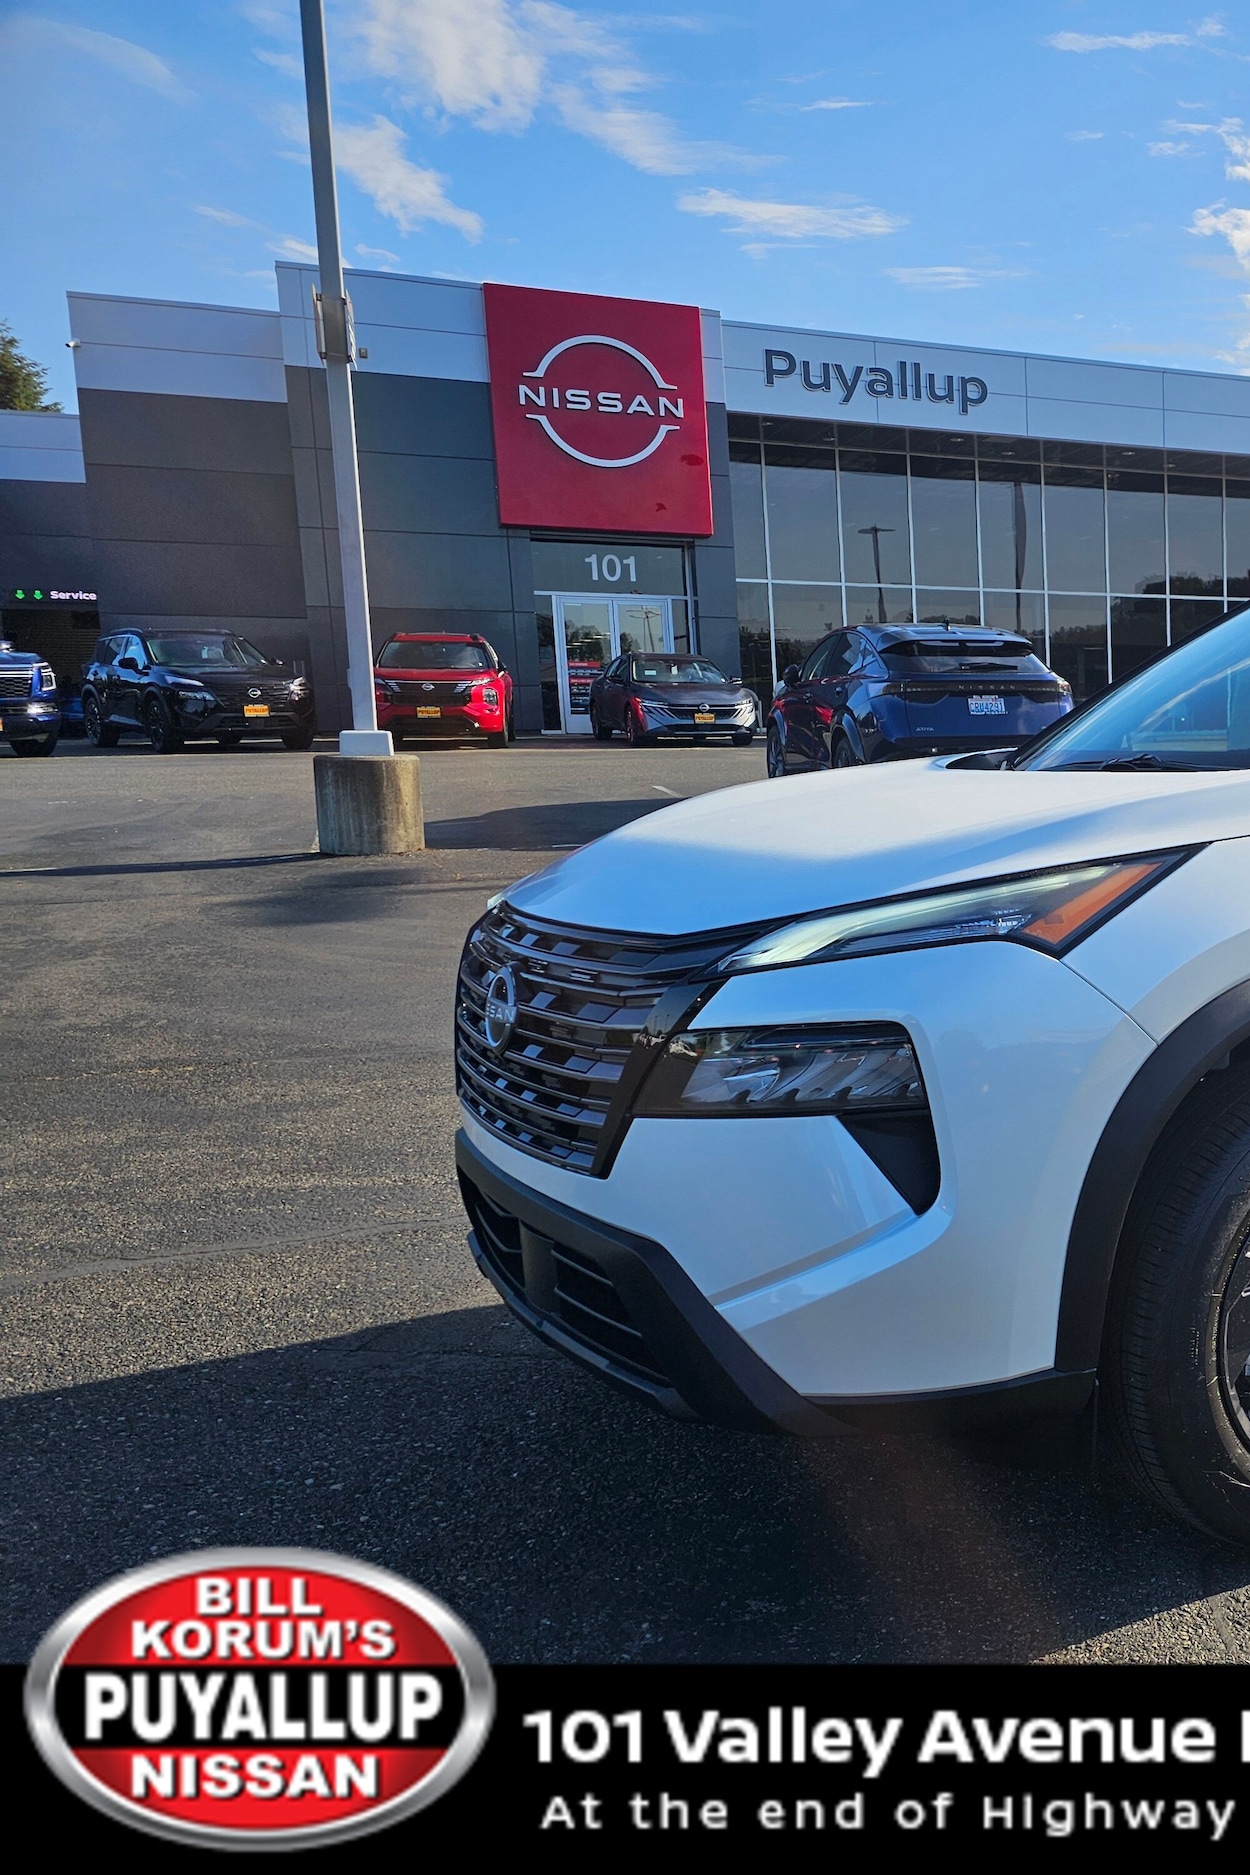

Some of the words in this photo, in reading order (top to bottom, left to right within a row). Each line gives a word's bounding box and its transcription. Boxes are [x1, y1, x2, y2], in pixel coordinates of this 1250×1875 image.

[764, 348, 989, 415] Puyallup
[518, 384, 684, 418] NISSAN
[584, 553, 637, 582] 101
[50, 590, 97, 600] Service
